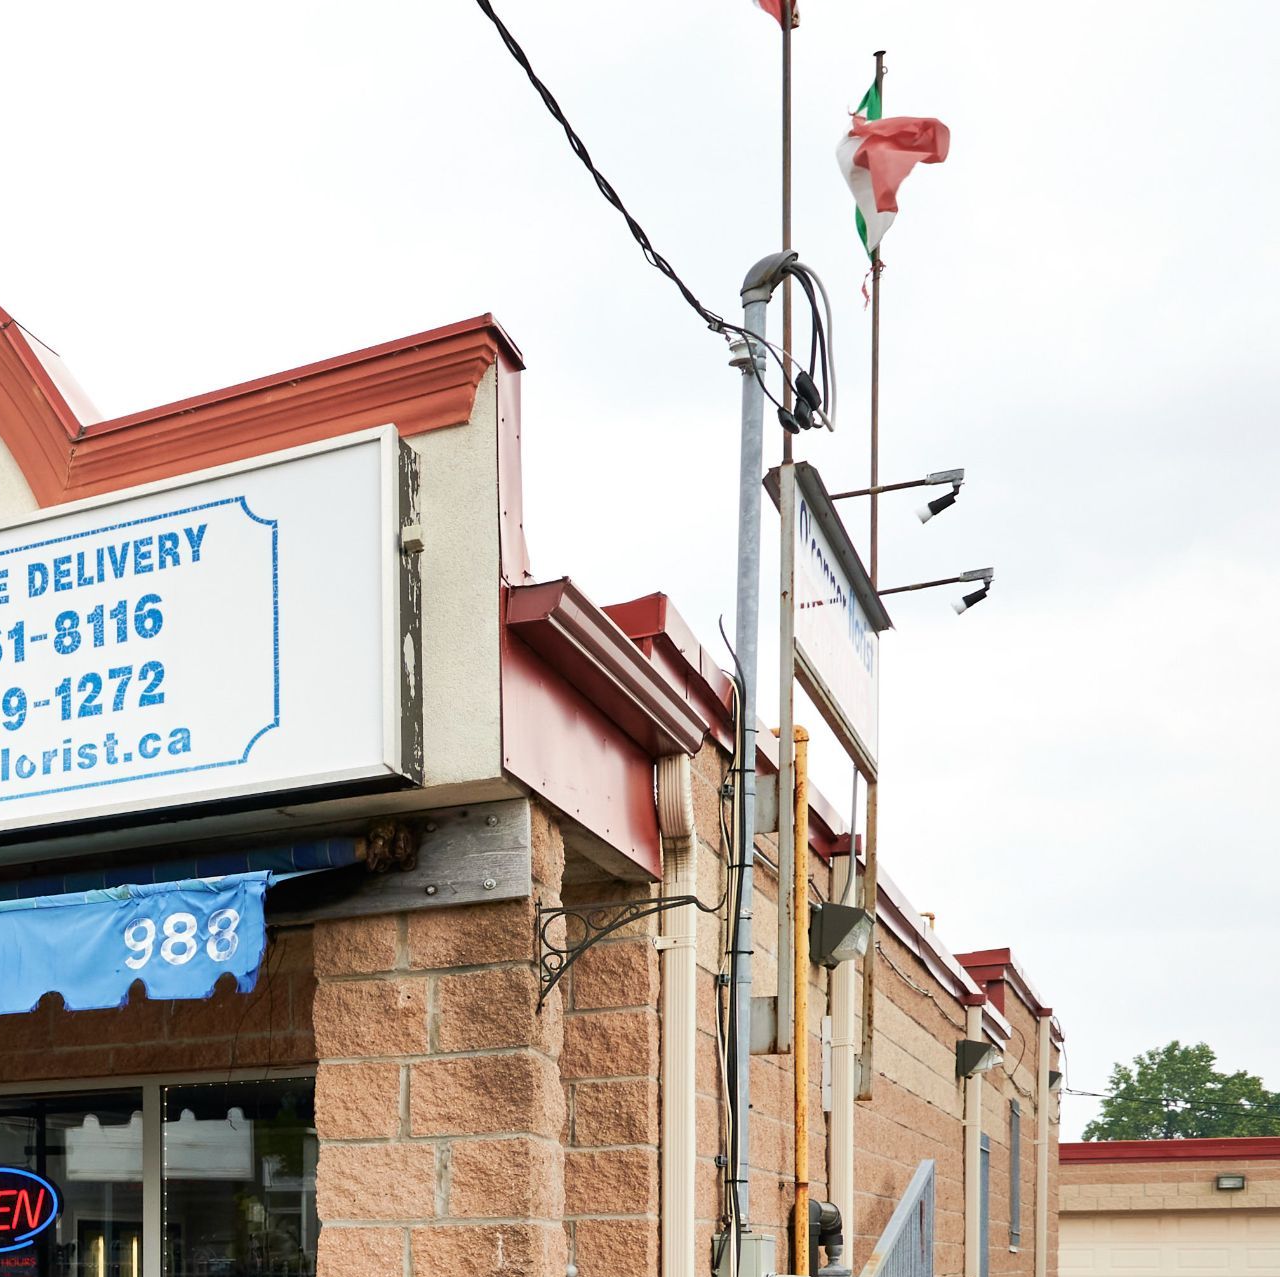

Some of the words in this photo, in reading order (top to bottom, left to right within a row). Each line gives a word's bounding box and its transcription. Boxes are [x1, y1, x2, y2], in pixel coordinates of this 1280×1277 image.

[27, 523, 209, 598] DELIVERY
[122, 908, 240, 971] 988
[1, 1256, 37, 1267] HOURS
